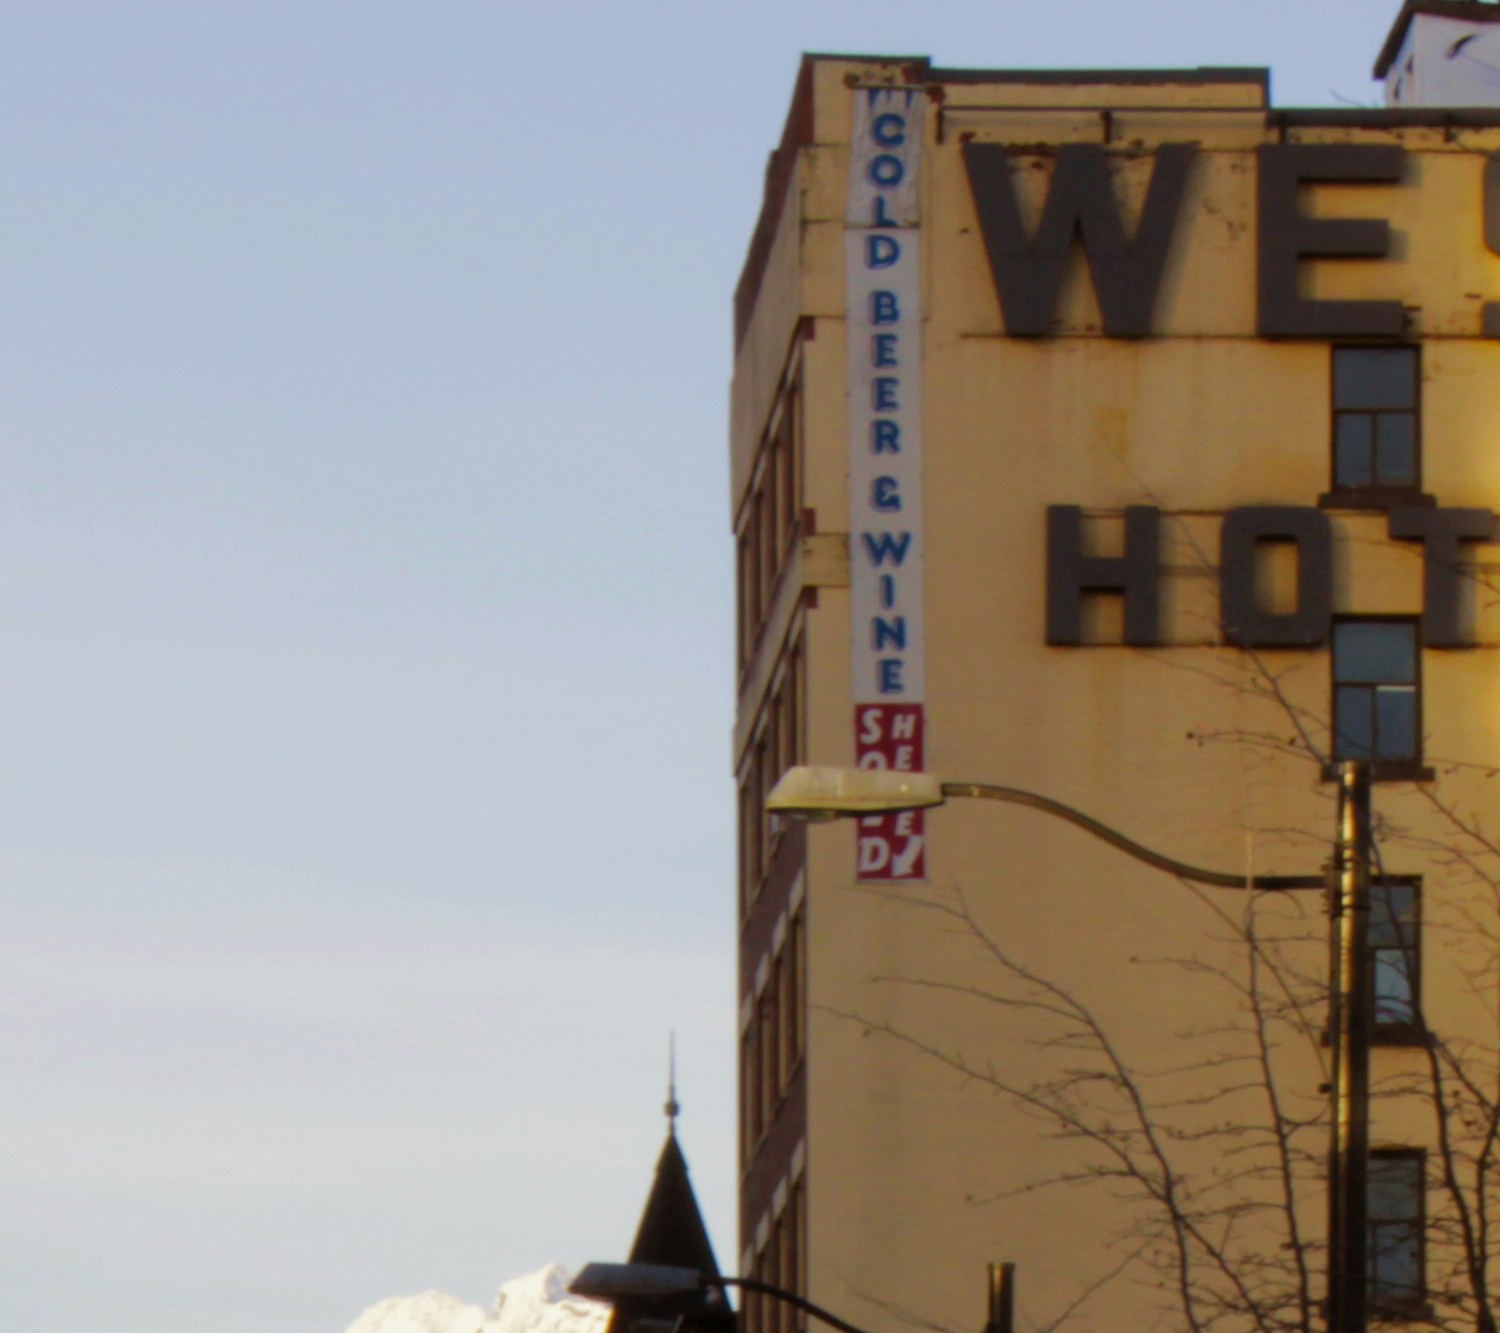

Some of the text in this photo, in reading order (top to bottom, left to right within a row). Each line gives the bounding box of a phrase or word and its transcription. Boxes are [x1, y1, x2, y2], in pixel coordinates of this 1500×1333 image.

[860, 112, 911, 694] COLD BEER & WINE
[891, 713, 916, 836] HEE
